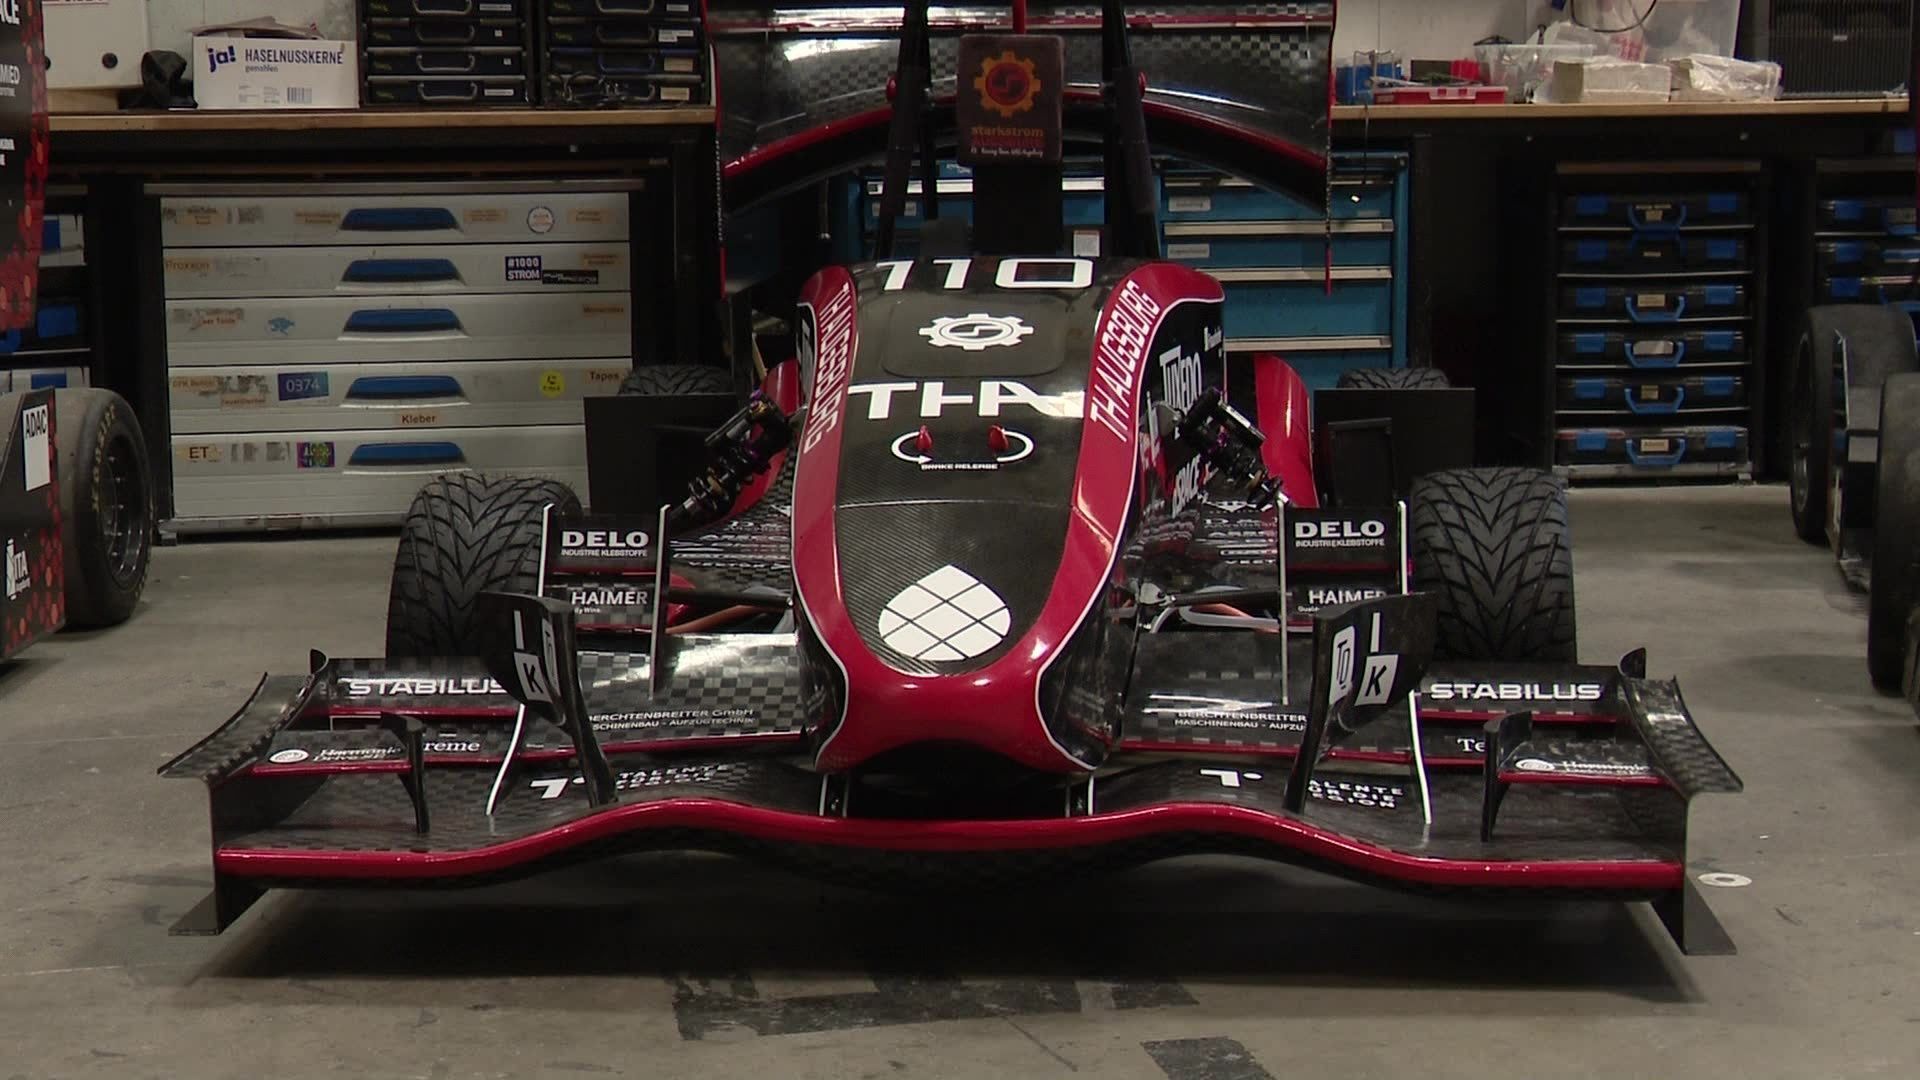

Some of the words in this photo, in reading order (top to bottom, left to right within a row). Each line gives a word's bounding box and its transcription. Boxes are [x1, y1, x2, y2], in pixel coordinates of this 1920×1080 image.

[207, 44, 237, 73] ja!
[244, 48, 344, 65] HASELNUSSKERNE
[507, 257, 540, 269] #1000
[507, 269, 540, 281] STROM
[876, 257, 1094, 291] 110
[590, 370, 619, 382] Tapes
[286, 378, 320, 394] 0374
[847, 381, 1085, 420] THA
[25, 408, 47, 438] ADAC
[401, 413, 436, 425] Kleber
[1294, 520, 1386, 539] DELO
[562, 530, 650, 548] DELO
[561, 548, 600, 557] INDUSTRIE
[601, 548, 648, 557] KLEBSTOFFE
[571, 591, 649, 606] HAIMER
[348, 678, 510, 696] STABILUS
[1430, 682, 1602, 701] STABILUS
[711, 708, 754, 717] GmbH
